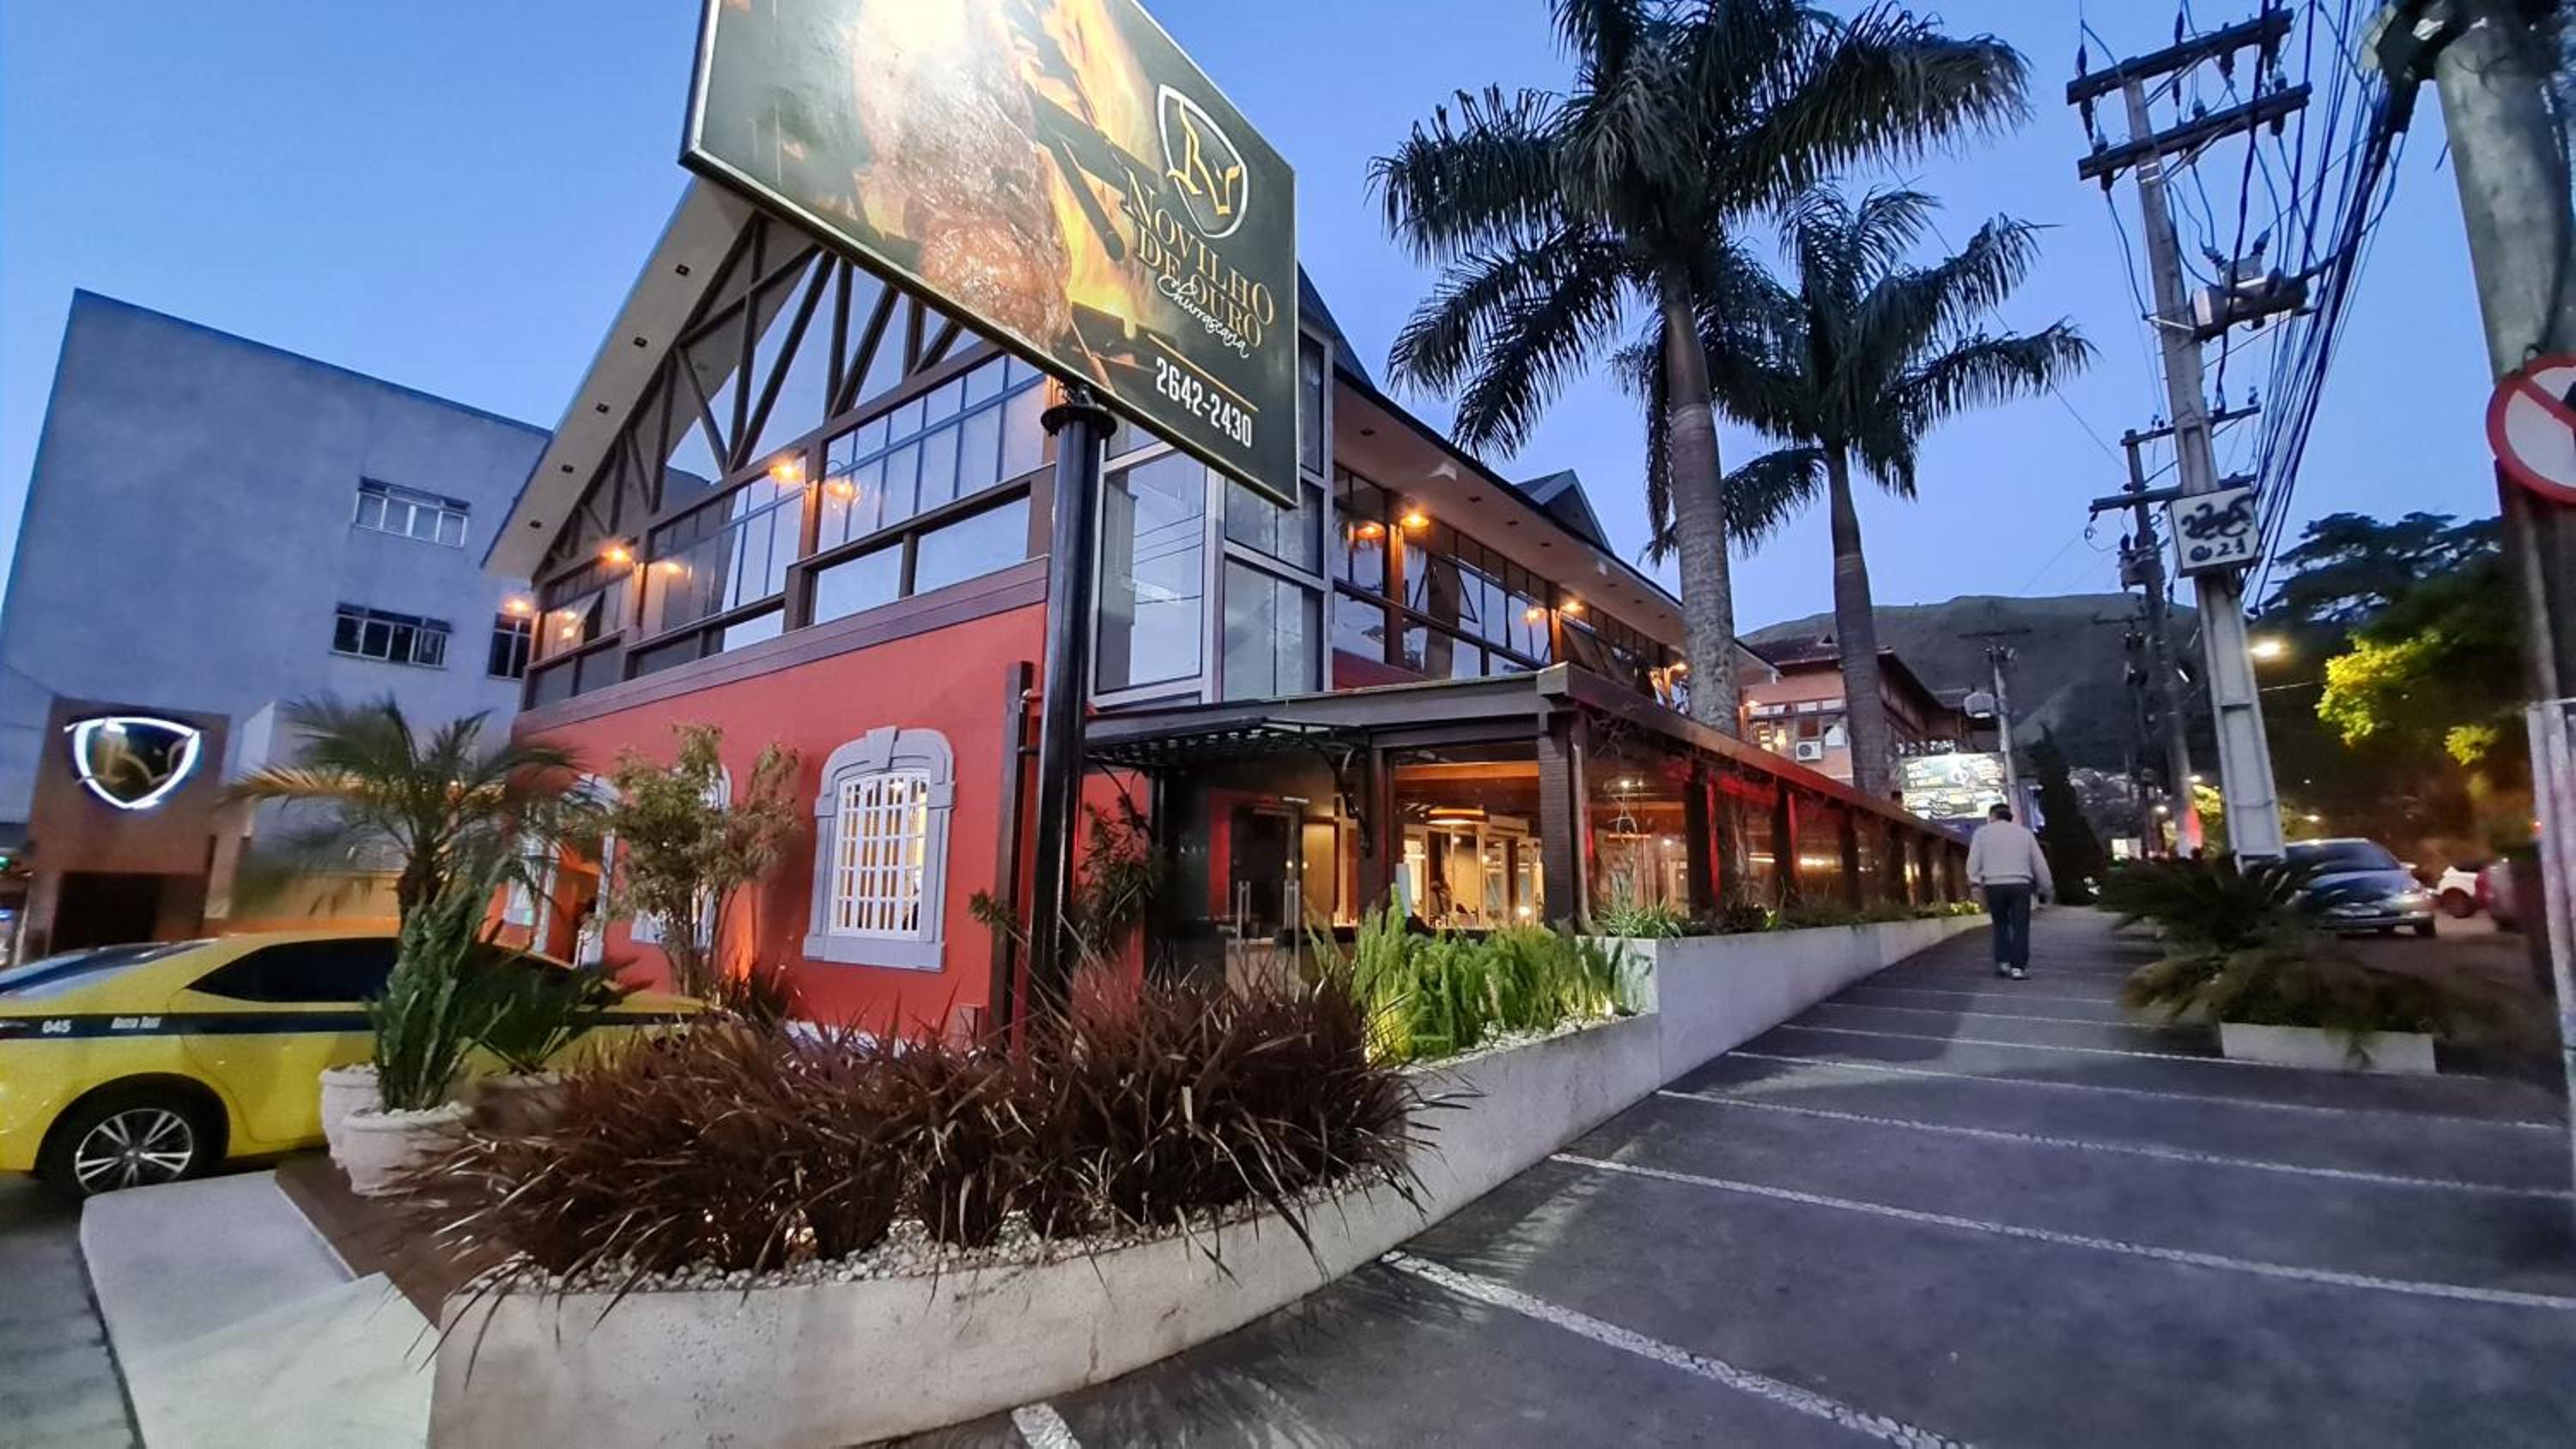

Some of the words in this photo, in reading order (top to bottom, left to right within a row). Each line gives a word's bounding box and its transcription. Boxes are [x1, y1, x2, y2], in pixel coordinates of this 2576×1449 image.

[1123, 167, 1273, 326] NOVILHO
[1138, 224, 1181, 286] DE
[1190, 274, 1261, 348] OURO
[1157, 276, 1249, 358] Churrascaria
[1156, 356, 1252, 448] 2642-2430
